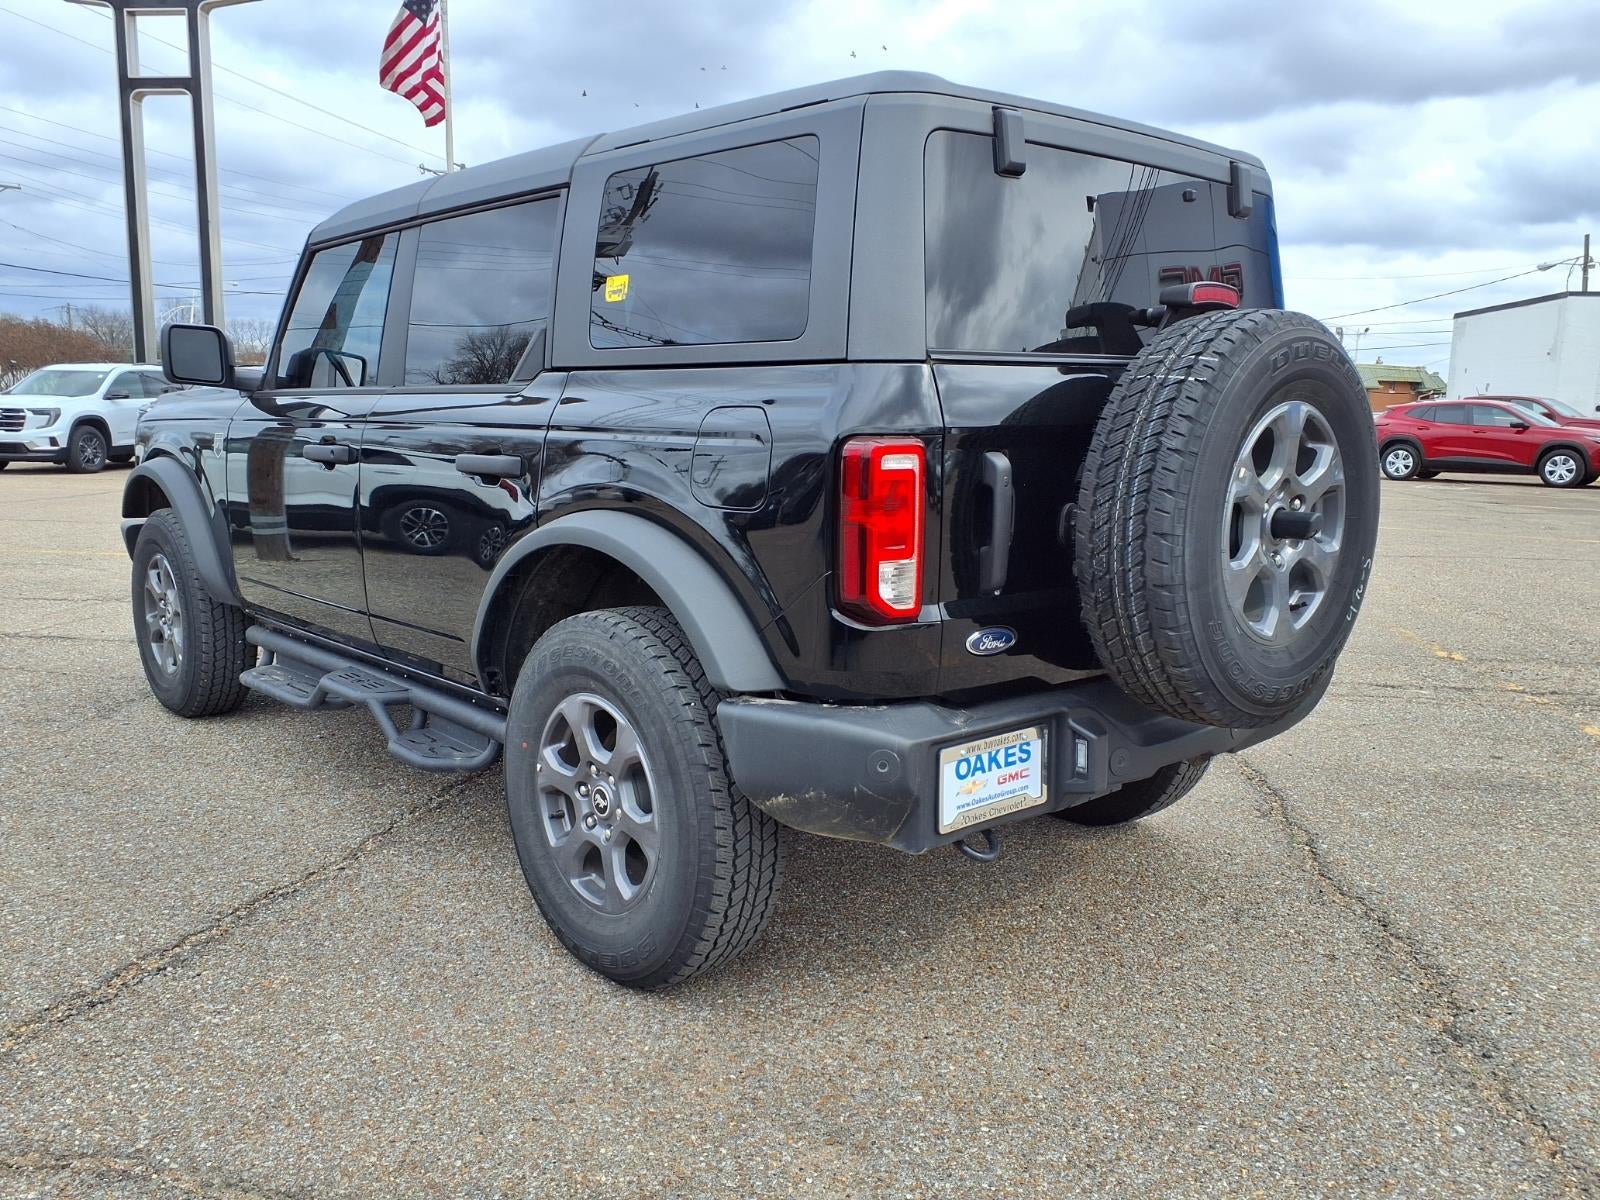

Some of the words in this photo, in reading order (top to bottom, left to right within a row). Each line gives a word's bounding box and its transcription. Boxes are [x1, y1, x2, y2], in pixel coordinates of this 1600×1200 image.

[955, 741, 1032, 780] OAKES
[997, 768, 1030, 785] GMC
[956, 785, 1029, 810] www.OakesAutoGroup.com
[964, 812, 987, 825] Oakes
[989, 800, 1024, 817] Chevrolet
